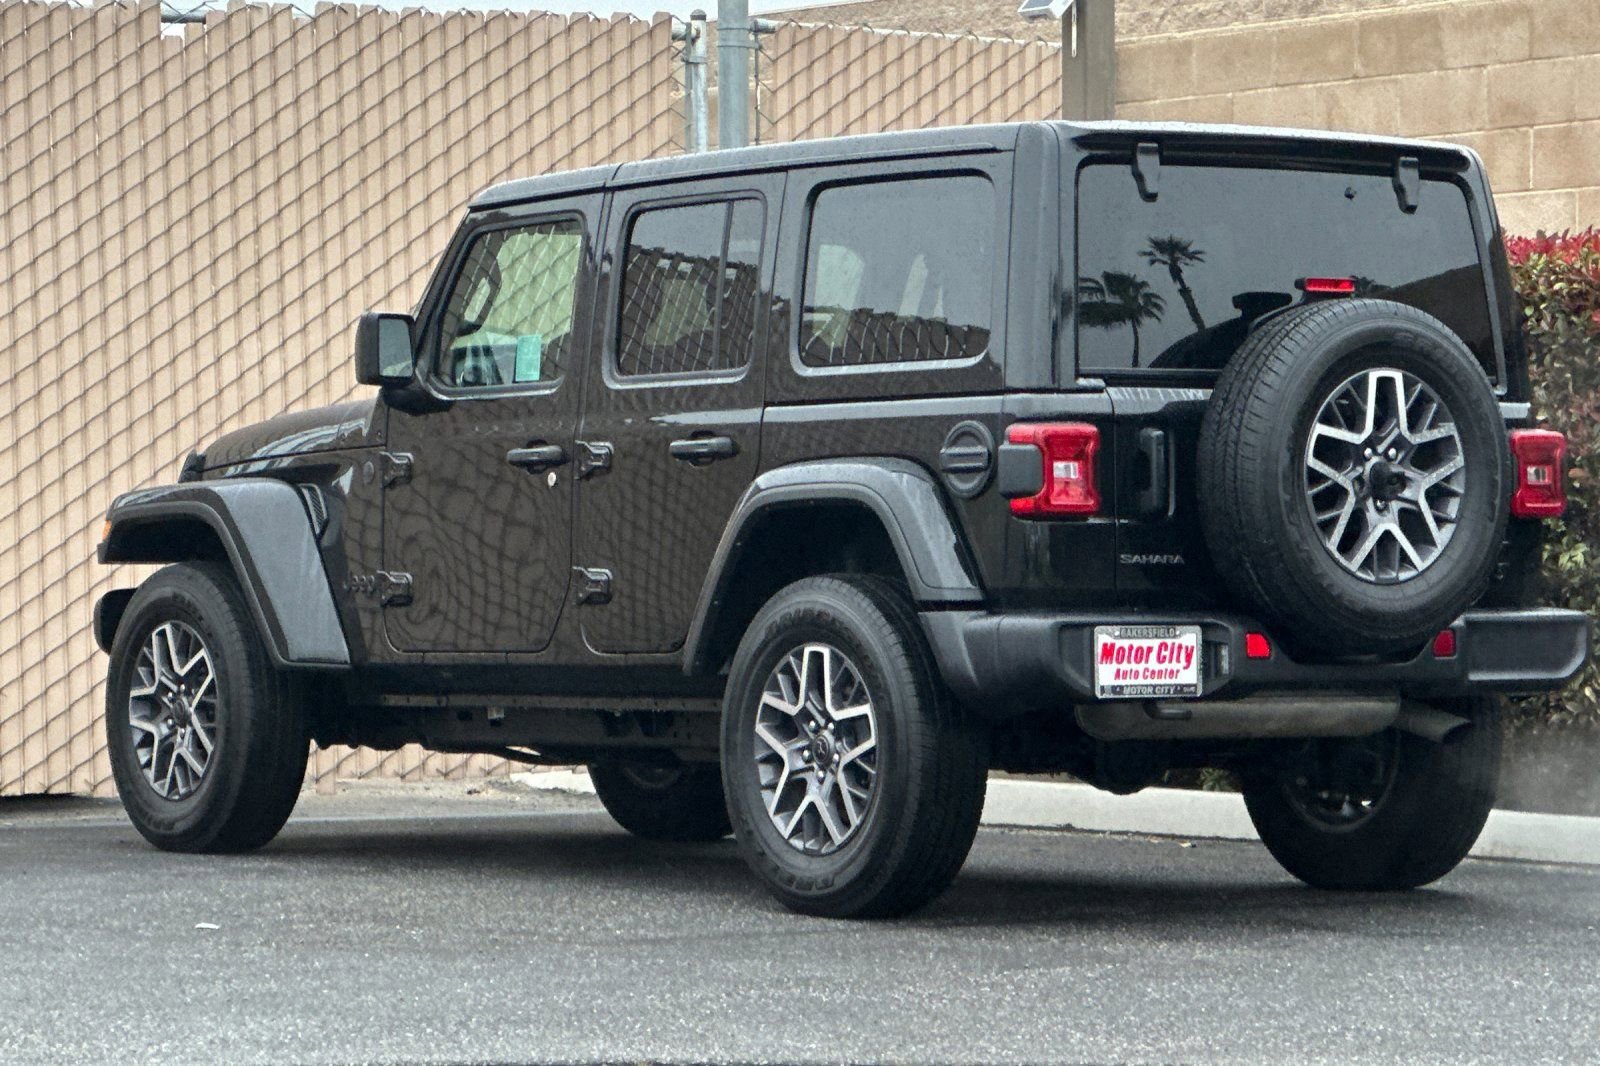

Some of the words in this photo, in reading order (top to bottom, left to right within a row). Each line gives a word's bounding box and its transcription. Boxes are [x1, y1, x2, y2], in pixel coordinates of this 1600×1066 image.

[1120, 553, 1185, 564] SAHARA
[1120, 627, 1175, 638] BAKERSFIELD
[1099, 642, 1153, 665] Motor
[1156, 641, 1195, 670] City
[1114, 668, 1140, 680] Auto
[1142, 667, 1181, 680] Center
[1123, 686, 1154, 695] MOTOR
[1155, 685, 1176, 694] CITY
